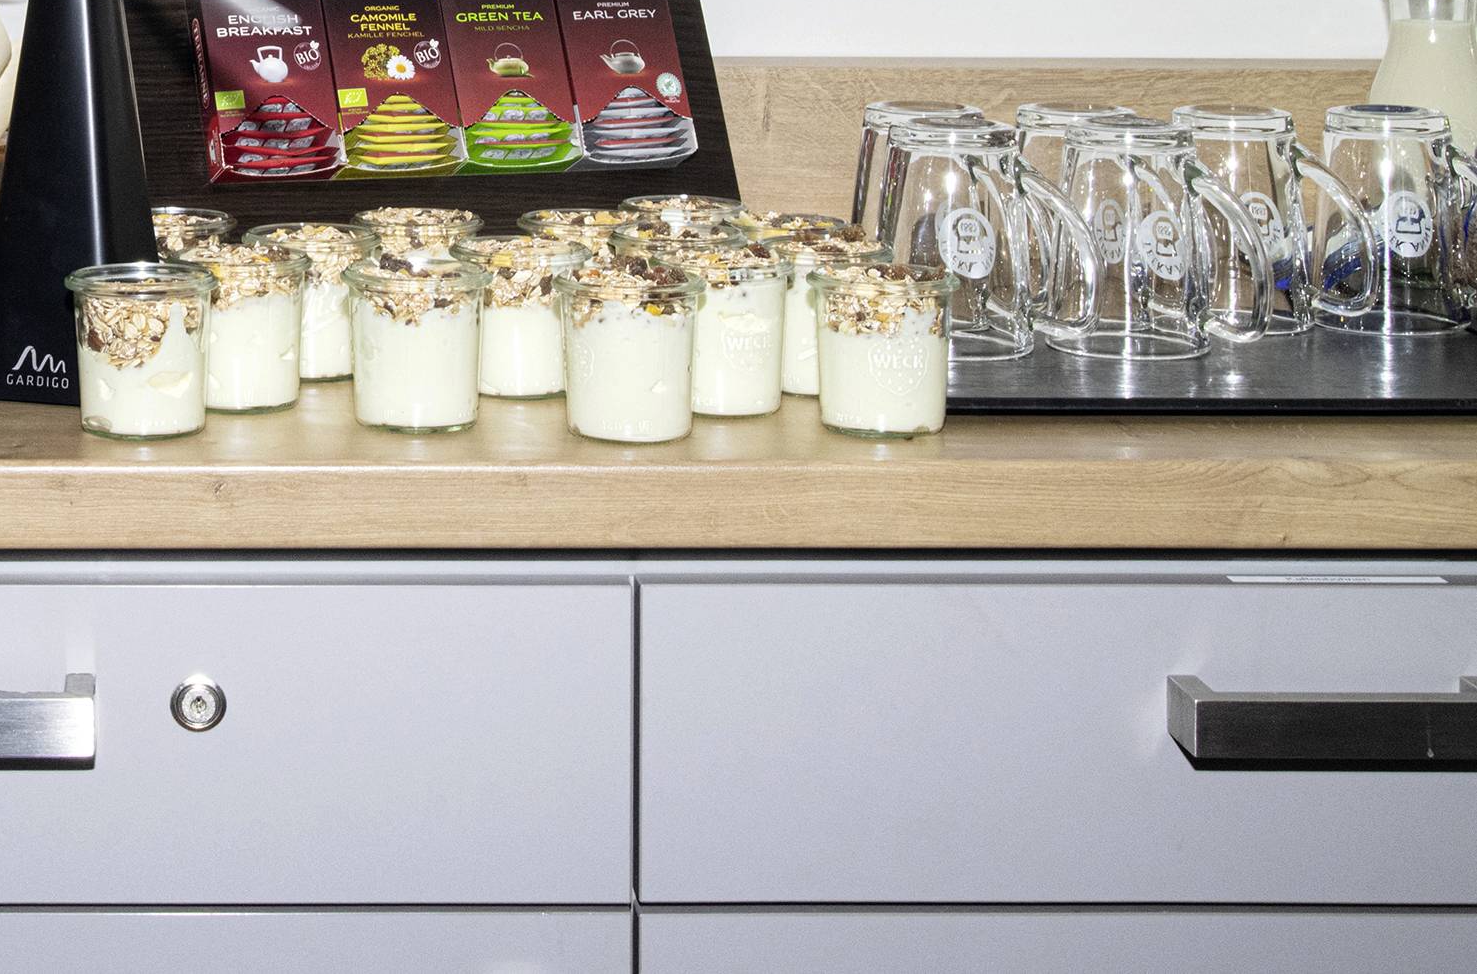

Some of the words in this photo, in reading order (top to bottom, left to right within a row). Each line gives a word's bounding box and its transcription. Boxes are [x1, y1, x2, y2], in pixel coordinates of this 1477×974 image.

[350, 13, 417, 23] CAMOMILE
[455, 12, 509, 23] GREEN
[512, 11, 544, 21] TEA
[572, 9, 614, 21] EARL
[617, 8, 656, 19] GREY
[216, 26, 312, 38] BREAKFAST
[360, 22, 411, 32] FENNEL
[386, 30, 425, 38] FENCHEL
[295, 48, 319, 65] BIO
[415, 47, 439, 64] BIO
[6, 372, 70, 391] GARDIGO
